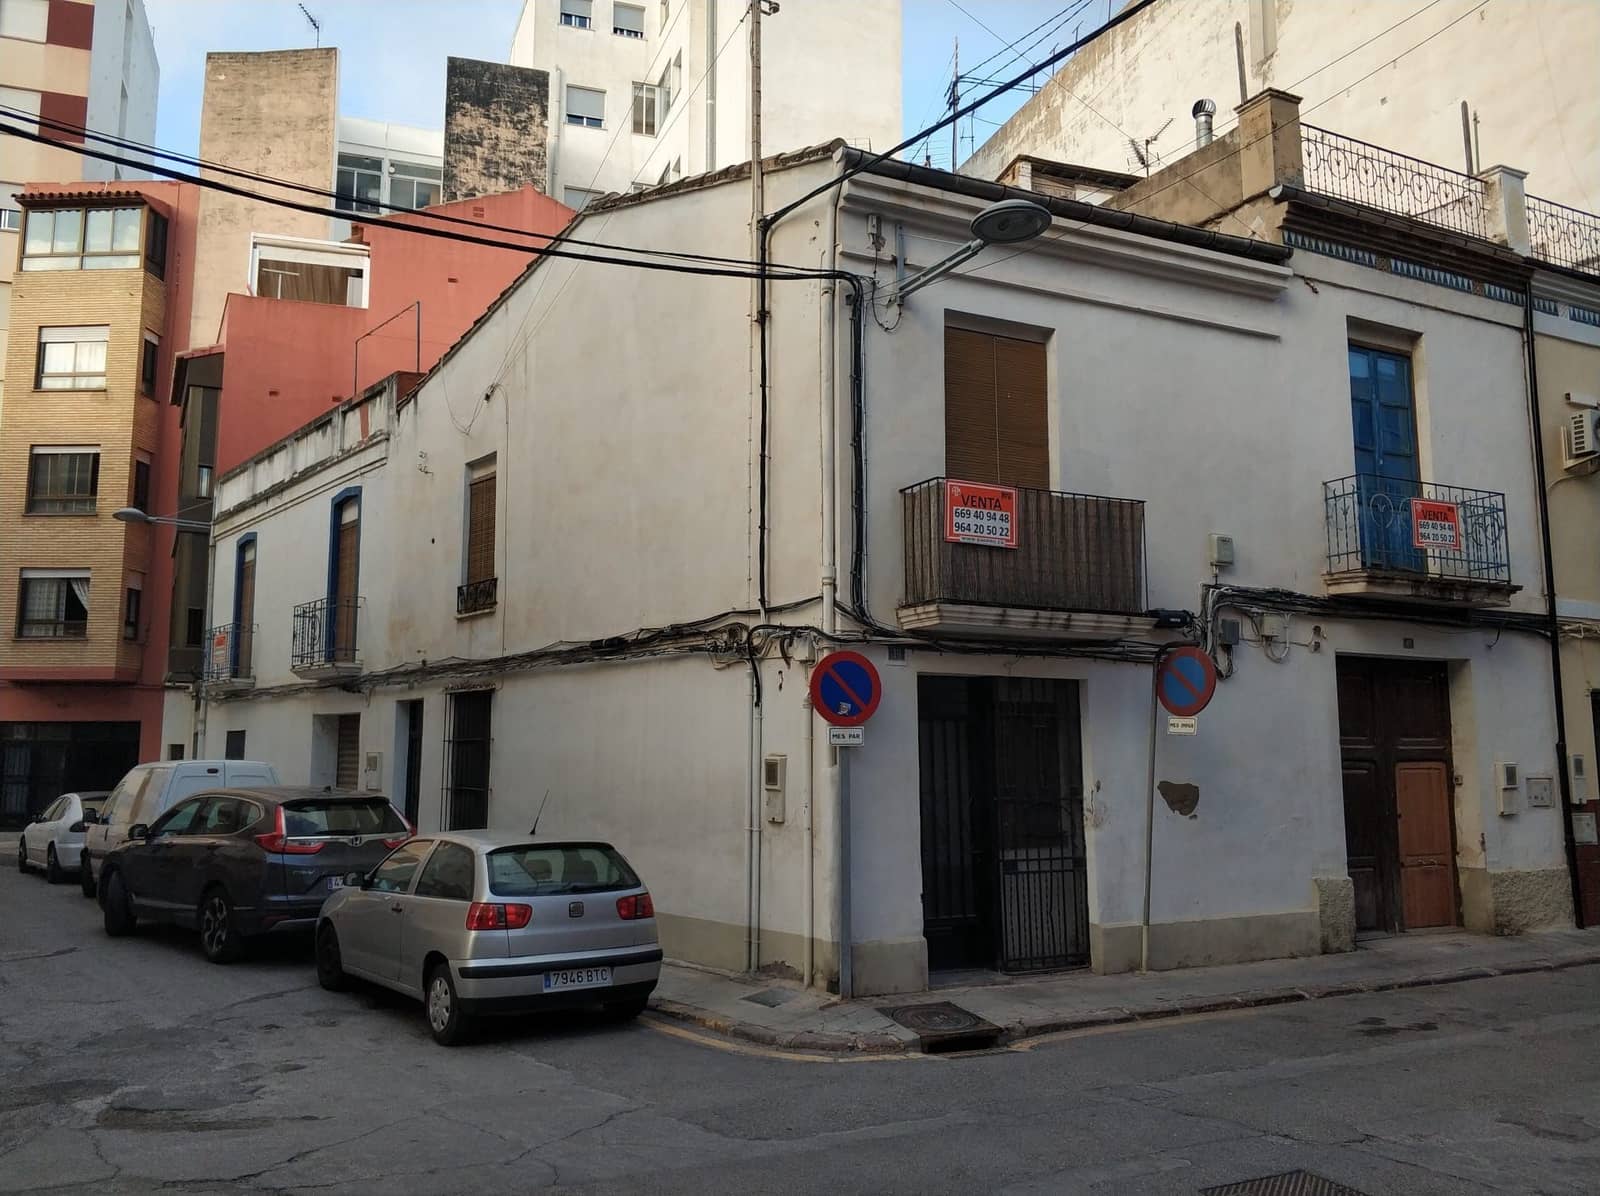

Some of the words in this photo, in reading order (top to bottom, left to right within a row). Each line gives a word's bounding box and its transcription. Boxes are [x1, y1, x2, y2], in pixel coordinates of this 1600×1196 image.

[961, 495, 1002, 511] VENTA
[954, 508, 971, 519] 669
[973, 510, 985, 521] 40
[986, 512, 997, 522] 94
[999, 514, 1009, 523] 48
[1422, 510, 1449, 521] VENTA
[954, 521, 971, 533] 964
[973, 524, 985, 534] 20
[986, 525, 998, 536] 50
[999, 527, 1009, 537] 22
[1431, 522, 1438, 530] 40
[1440, 534, 1448, 542] 50
[1448, 535, 1455, 543] 22
[553, 970, 583, 986] 7946
[586, 968, 608, 982] BTC
